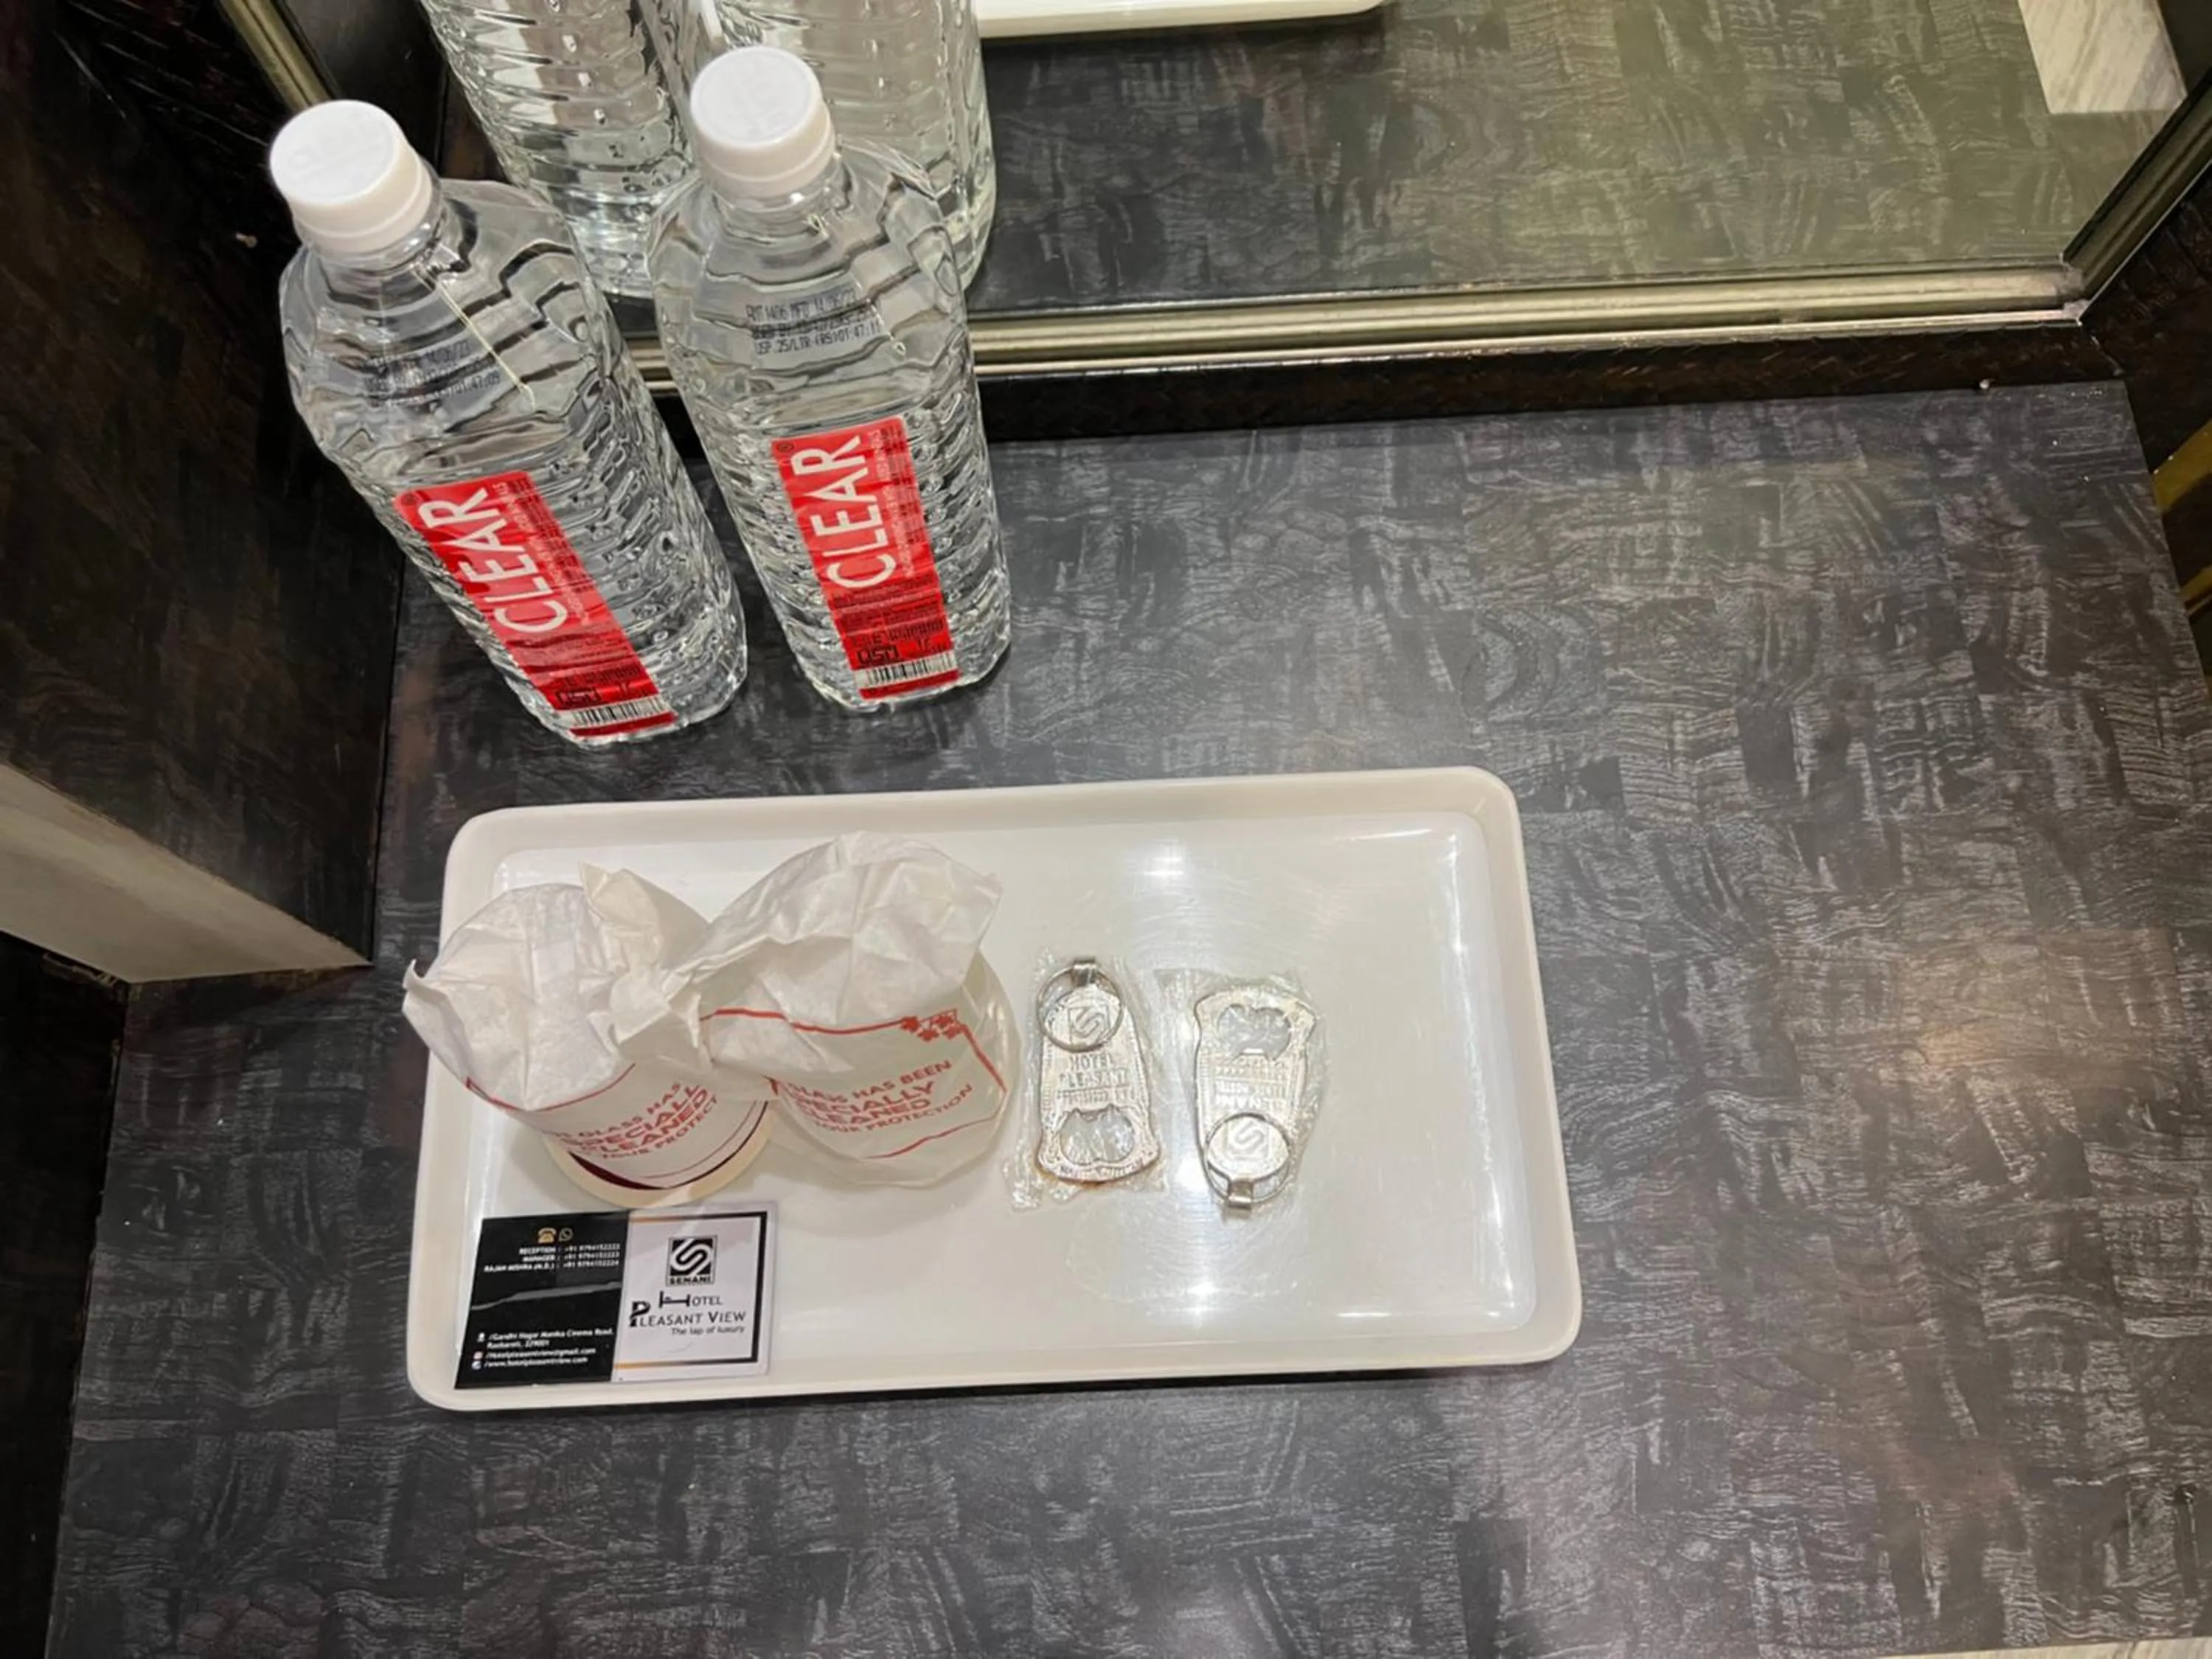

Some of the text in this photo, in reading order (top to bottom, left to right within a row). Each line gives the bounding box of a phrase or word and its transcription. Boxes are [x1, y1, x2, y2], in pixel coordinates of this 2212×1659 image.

[790, 434, 897, 589] CLEAR
[417, 487, 568, 633] CLEAR
[851, 1079, 895, 1099] HAS
[899, 1058, 953, 1085] BEEN
[645, 1081, 681, 1116] HAS
[865, 1082, 975, 1131] PROTECTION
[629, 1300, 747, 1327] PLEASANT VIEW
[658, 1290, 723, 1309] HOTEL
[689, 1327, 704, 1335] lap
[706, 1326, 715, 1334] of
[717, 1326, 745, 1334] luxury
